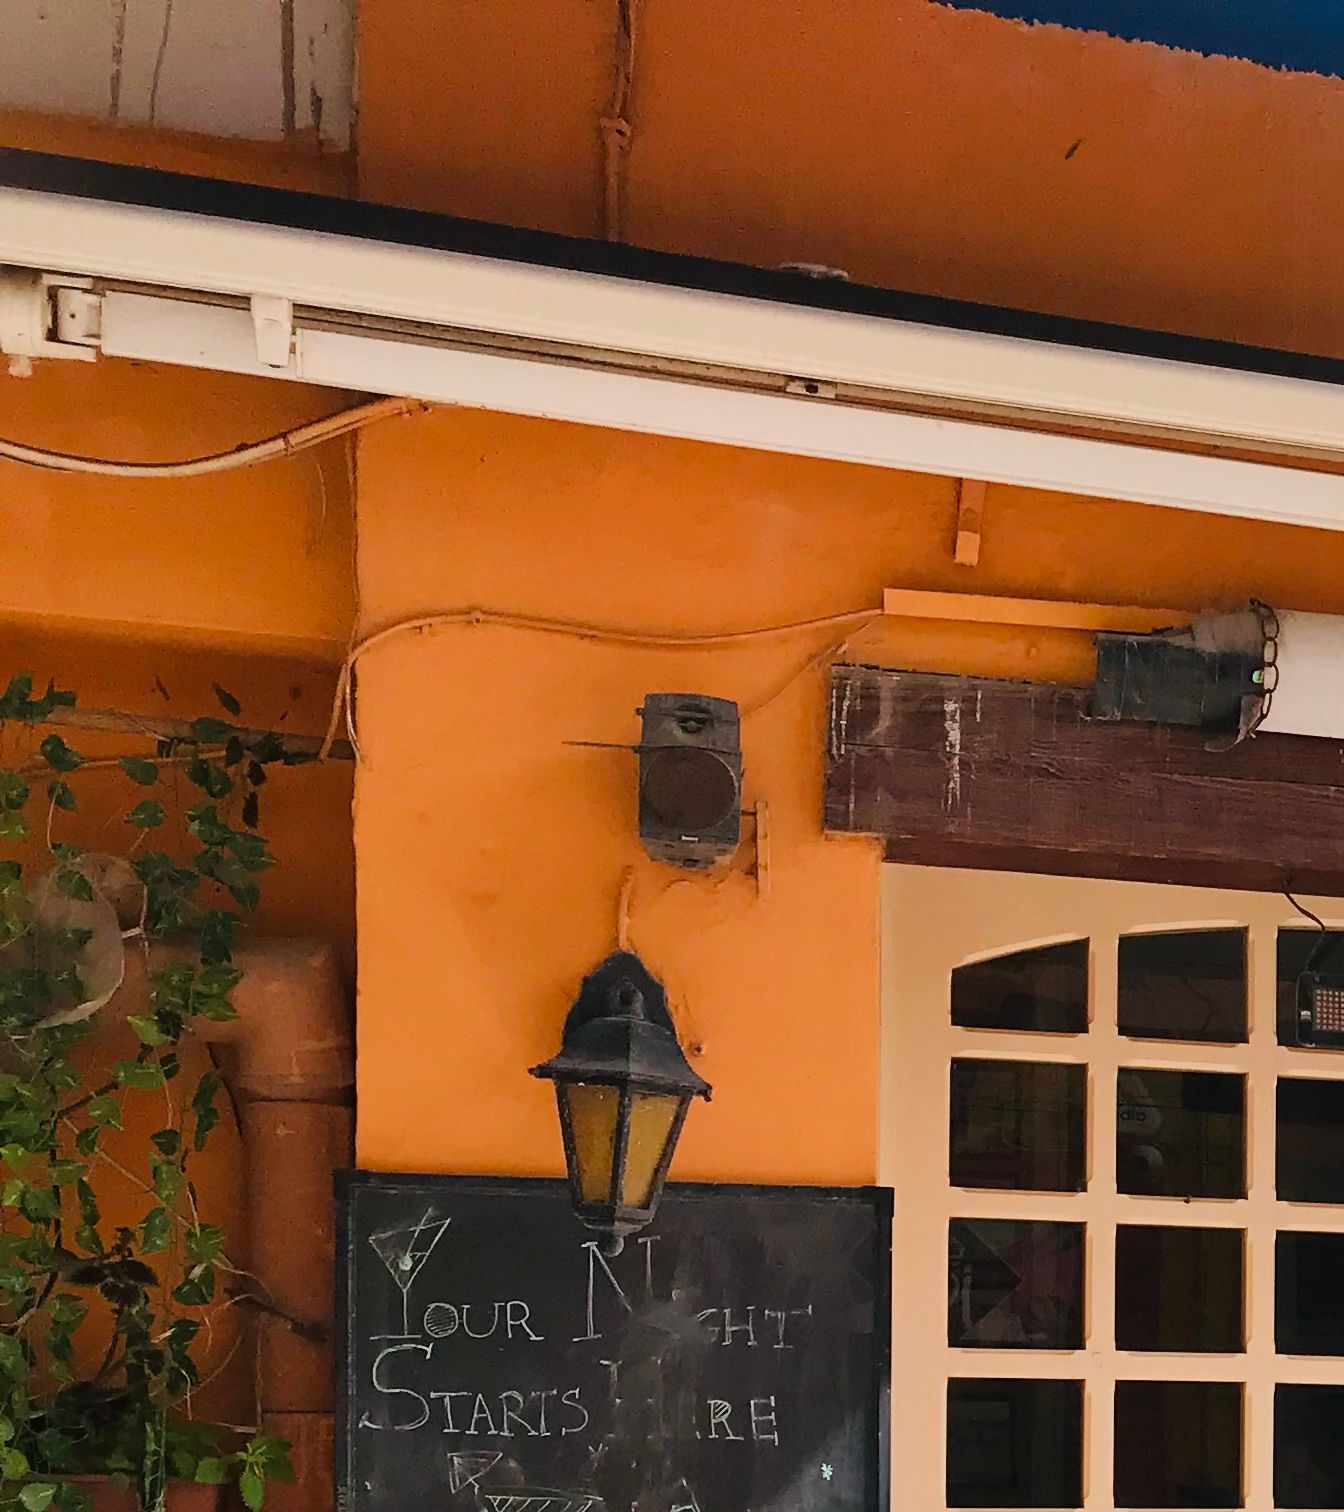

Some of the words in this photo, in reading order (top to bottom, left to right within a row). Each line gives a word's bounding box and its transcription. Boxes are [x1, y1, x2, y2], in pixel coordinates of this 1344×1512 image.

[369, 1208, 544, 1341] YOUR
[573, 1236, 812, 1348] NGHT
[359, 1343, 588, 1437] STARTS
